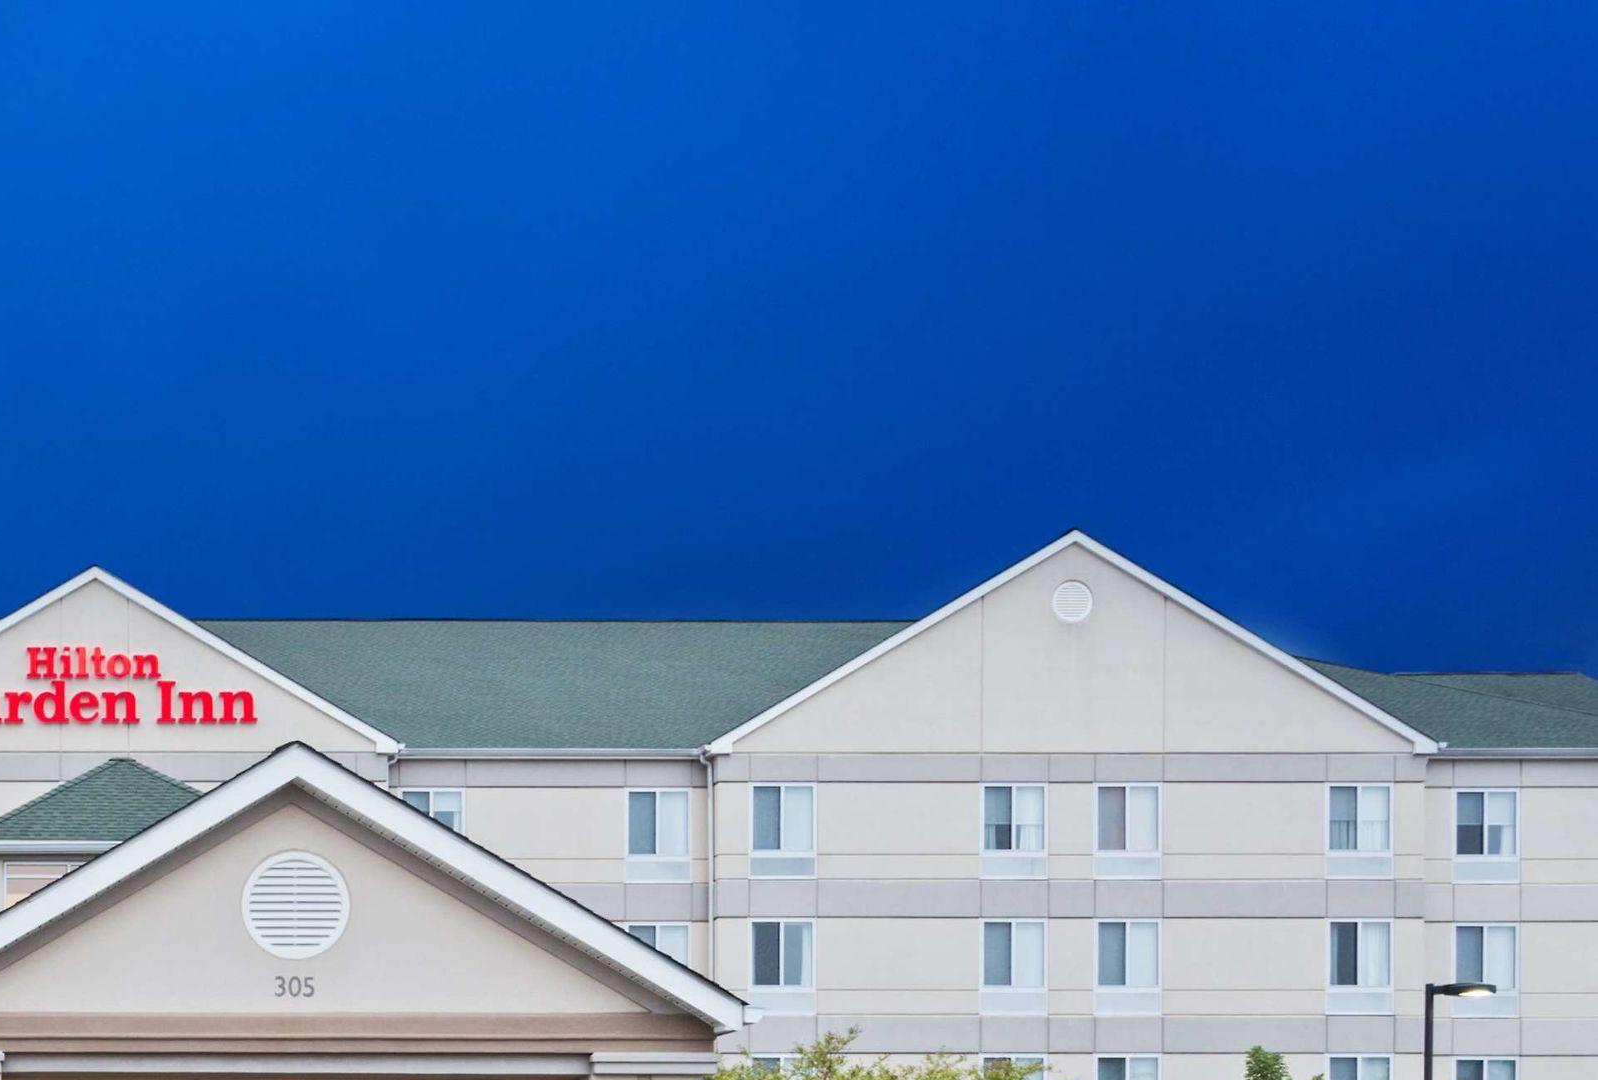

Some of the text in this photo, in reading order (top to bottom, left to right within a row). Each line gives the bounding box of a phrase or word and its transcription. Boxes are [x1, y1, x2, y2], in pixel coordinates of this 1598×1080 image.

[26, 646, 161, 679] Hilton
[155, 681, 258, 724] Inn
[275, 975, 315, 998] 305
